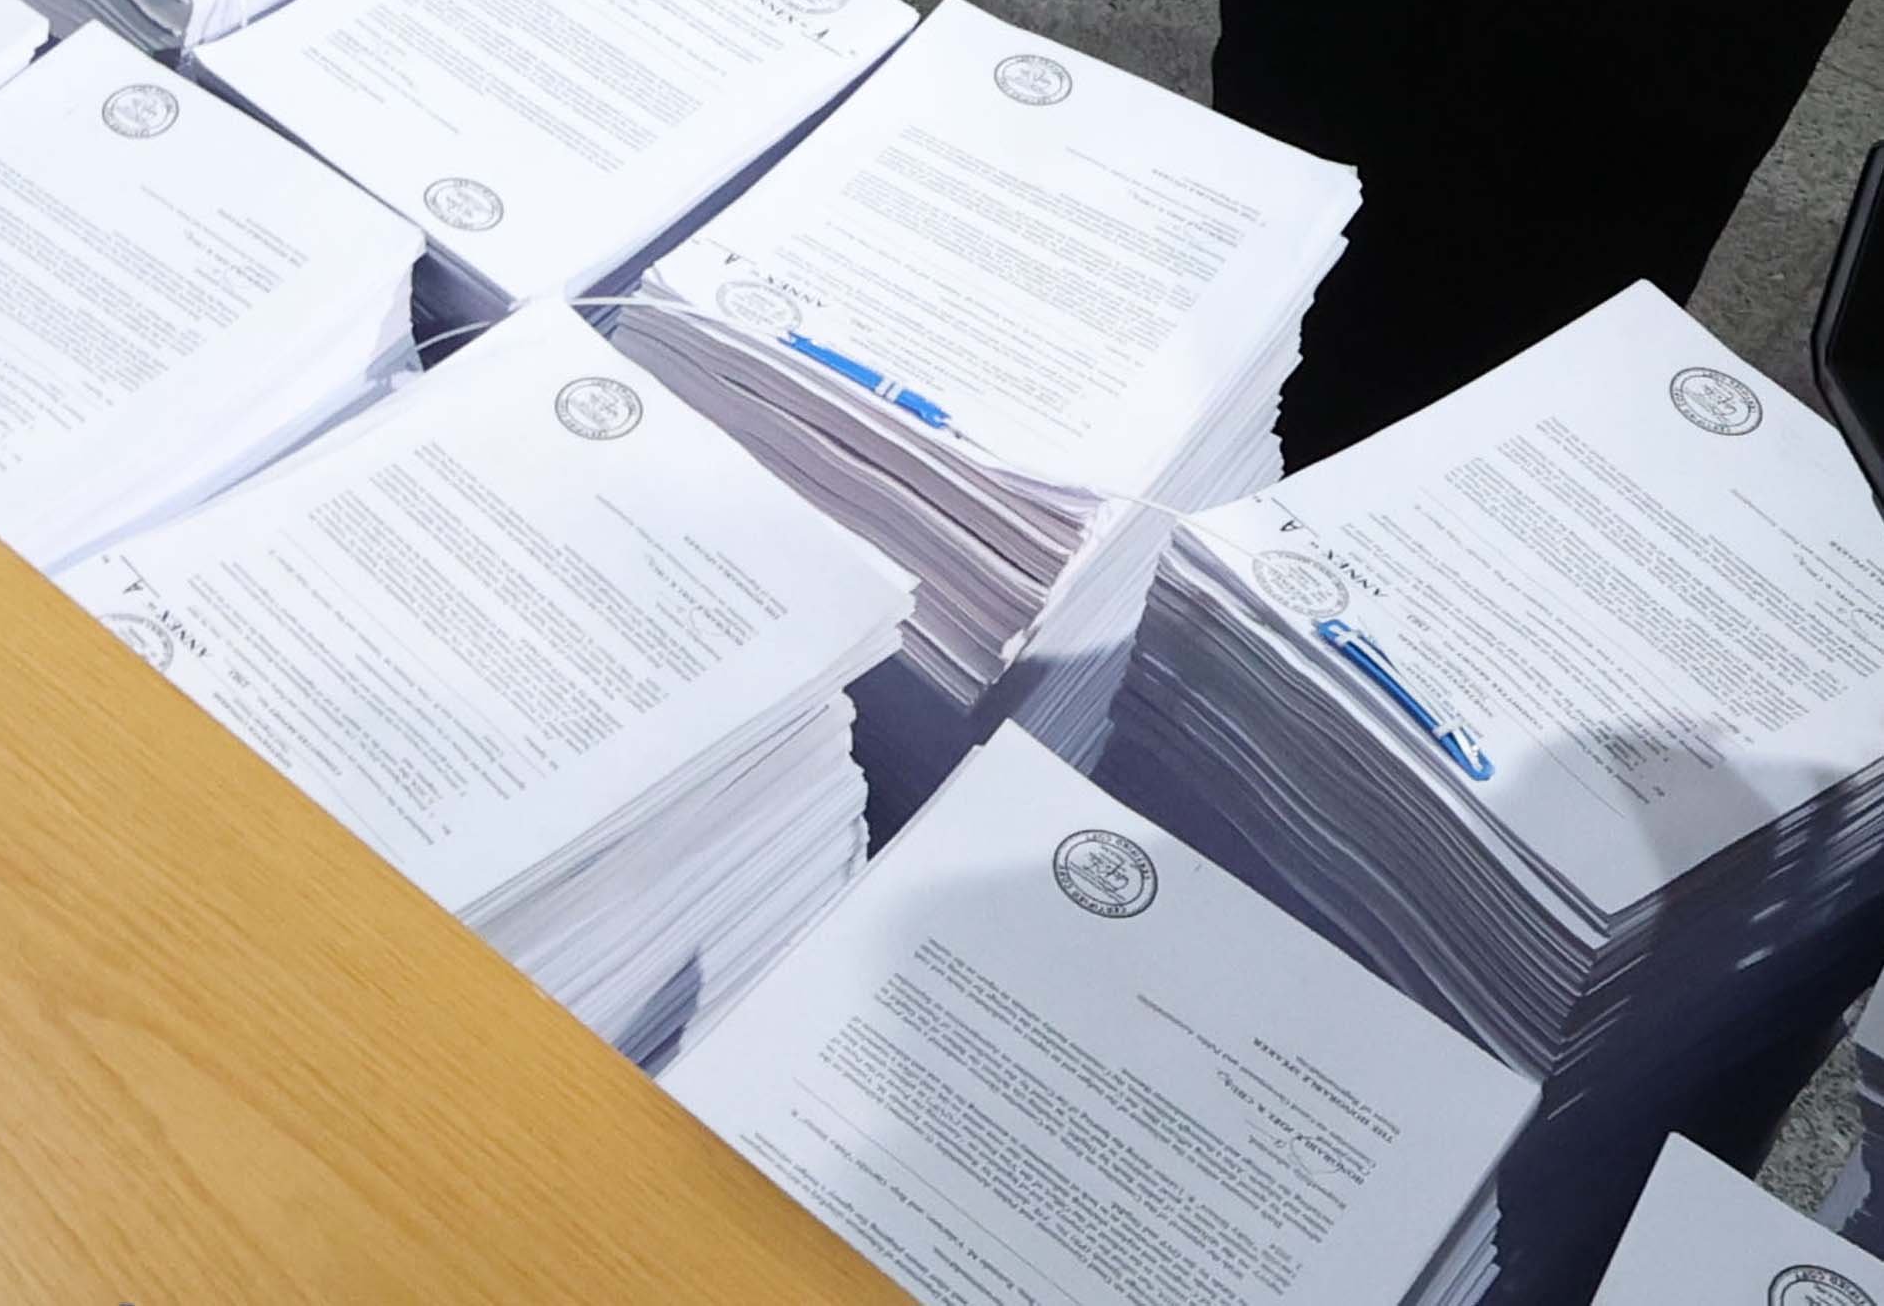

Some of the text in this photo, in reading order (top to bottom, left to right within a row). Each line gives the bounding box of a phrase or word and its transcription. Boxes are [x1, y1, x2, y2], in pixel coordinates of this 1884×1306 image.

[764, 271, 826, 311] ANNEX
[1321, 546, 1389, 603] ANNEX
[154, 605, 212, 661] ANNEX
[1114, 836, 1149, 880] CERTIFIED
[1058, 864, 1126, 914] CERTIFIED COPY
[1249, 1035, 1395, 1145] THE HONORABLE SPEAKER
